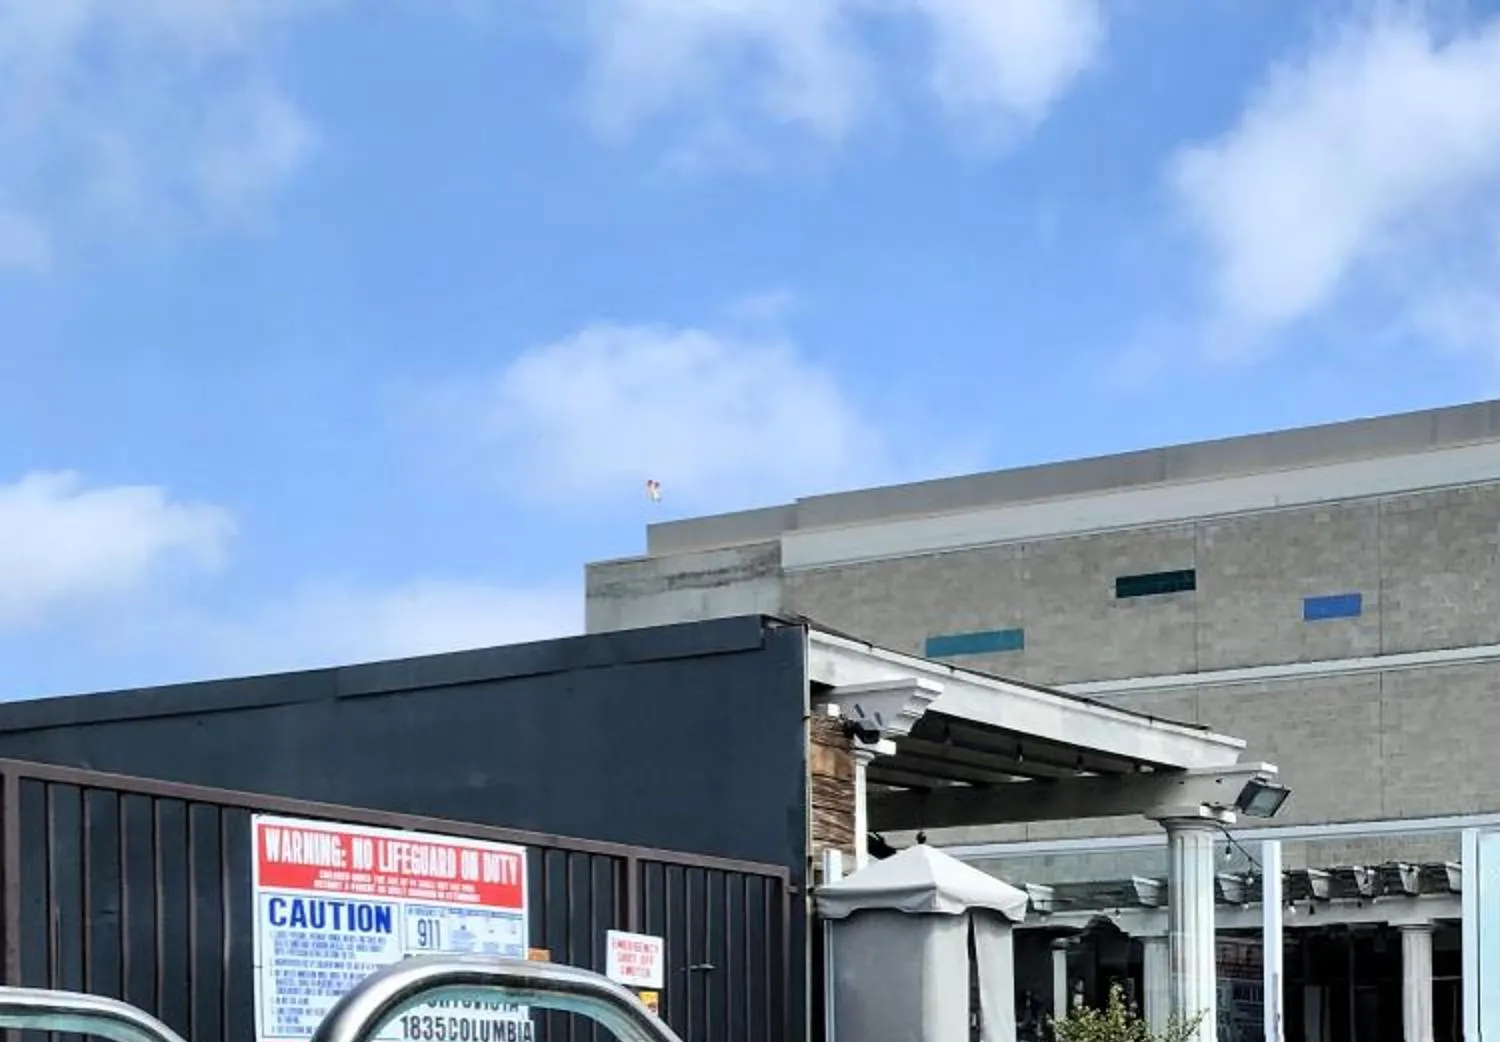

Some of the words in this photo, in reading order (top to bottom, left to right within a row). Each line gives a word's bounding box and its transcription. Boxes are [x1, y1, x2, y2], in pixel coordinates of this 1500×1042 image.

[264, 826, 347, 868] WARNING:
[352, 836, 373, 870] NO
[378, 839, 457, 880] LIFEGUARD
[461, 849, 479, 882] ON
[483, 852, 518, 886] DUTY
[268, 897, 393, 934] CAUTION
[417, 918, 440, 951] 911
[401, 1015, 446, 1042] 1835
